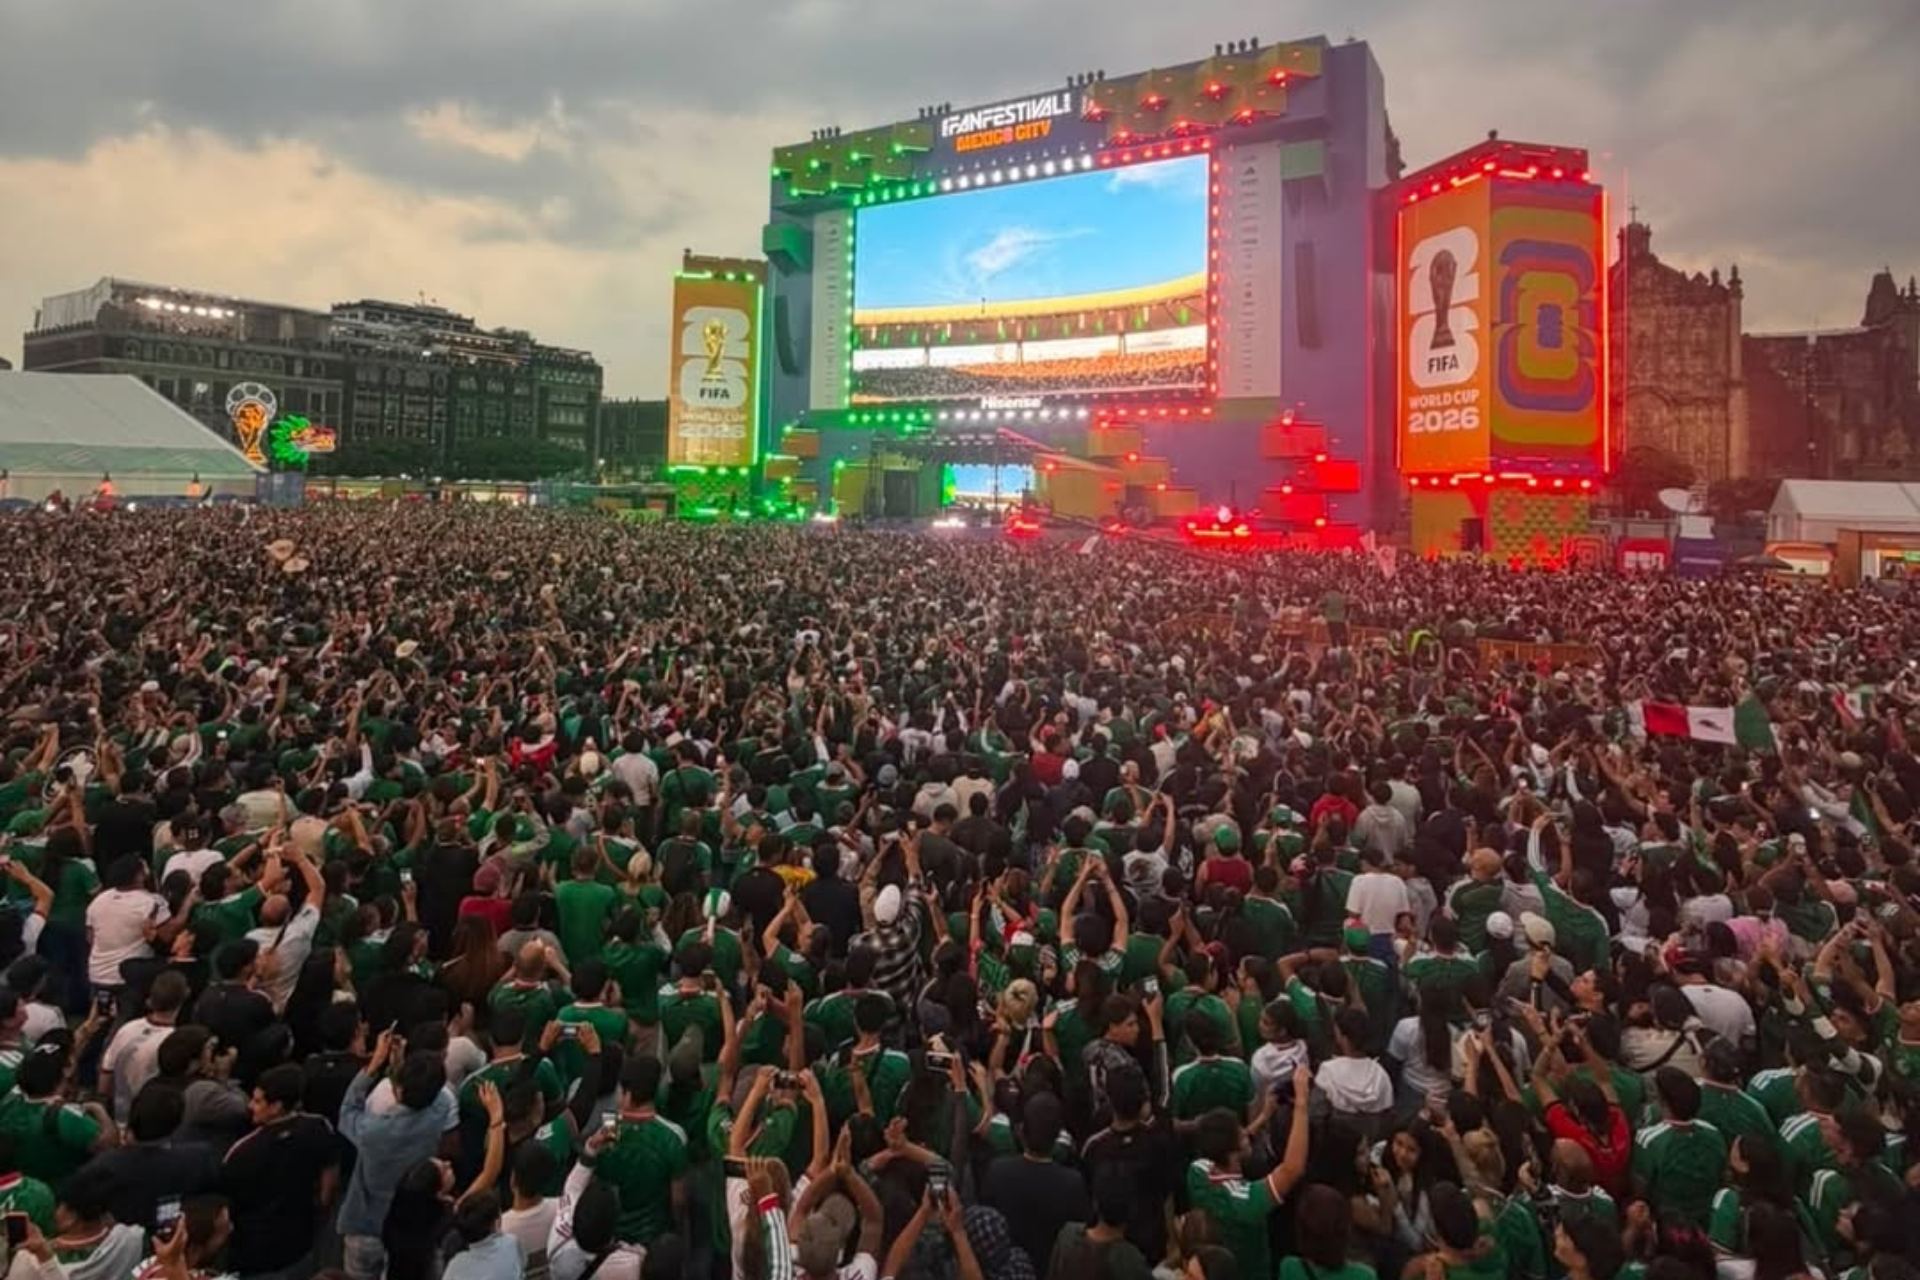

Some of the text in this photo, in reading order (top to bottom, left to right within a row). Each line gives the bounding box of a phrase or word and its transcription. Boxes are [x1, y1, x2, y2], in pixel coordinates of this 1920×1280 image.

[956, 120, 1052, 153] MEXICO CITY
[1427, 354, 1460, 375] FIFA
[700, 387, 730, 400] FIFA
[1408, 388, 1480, 409] WORLD CUP
[1408, 405, 1480, 434] 2026
